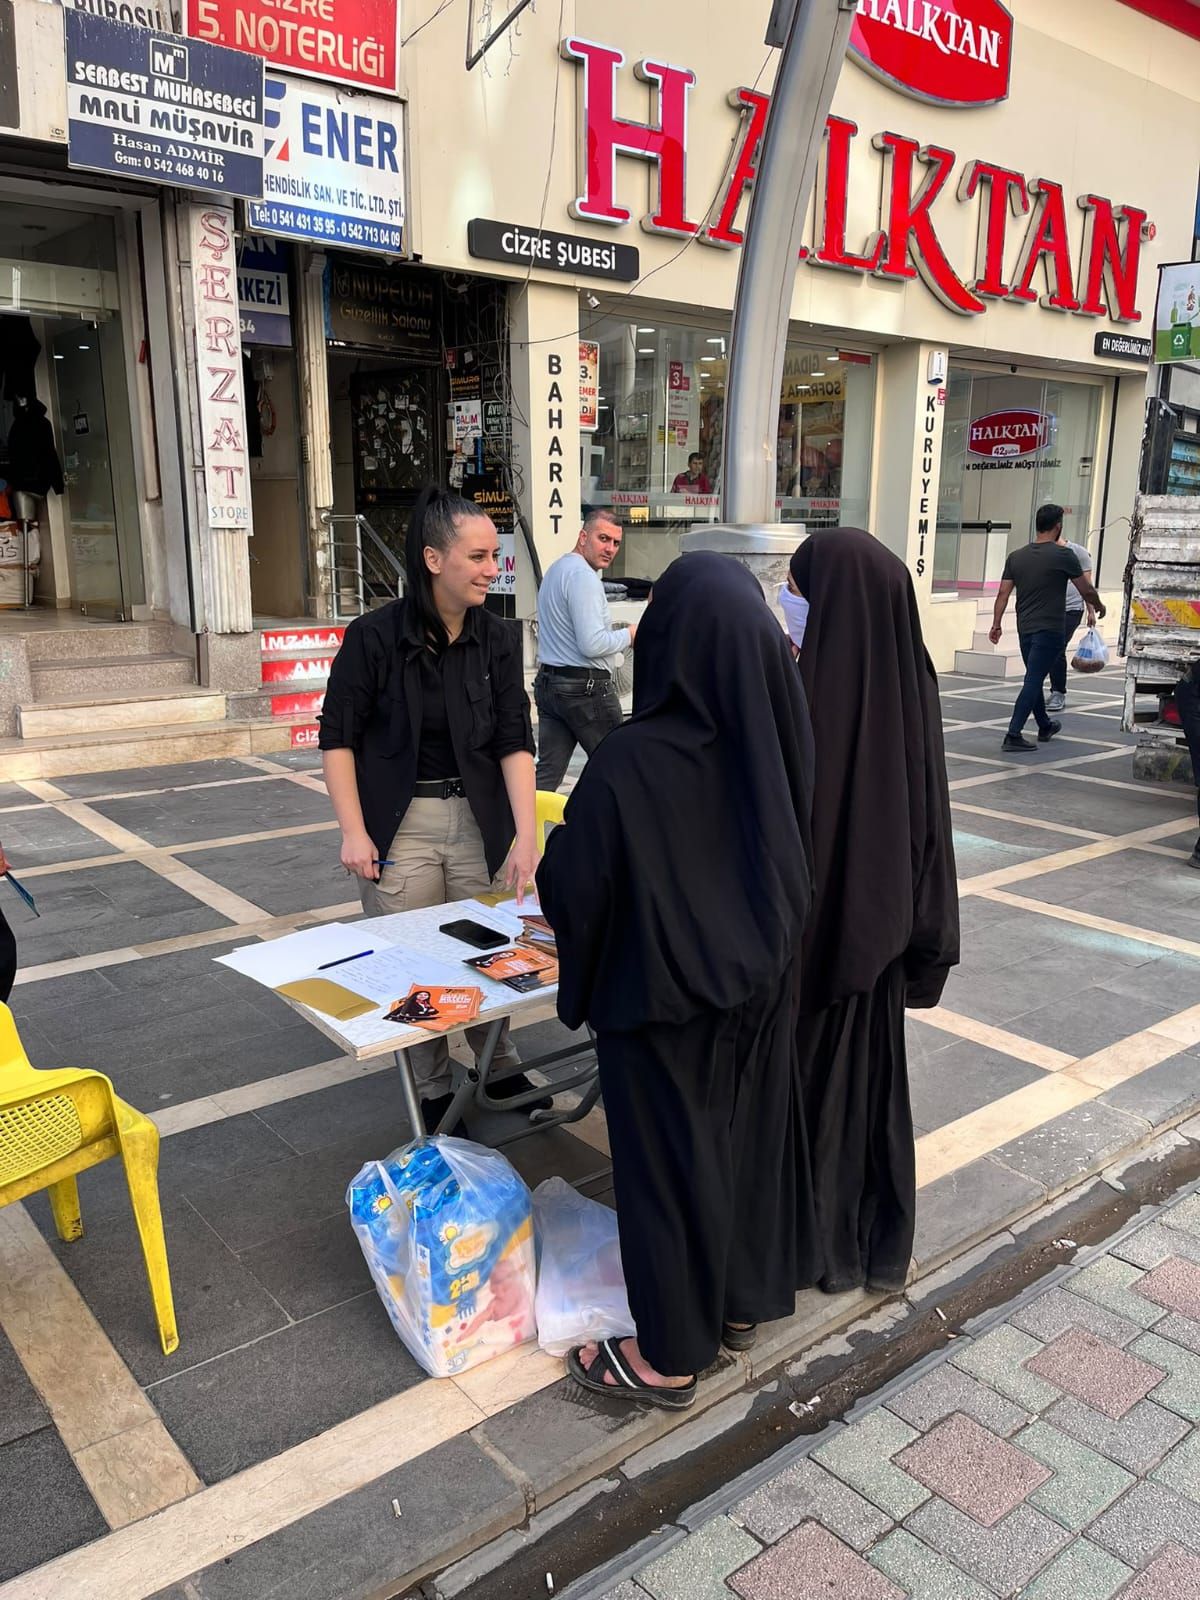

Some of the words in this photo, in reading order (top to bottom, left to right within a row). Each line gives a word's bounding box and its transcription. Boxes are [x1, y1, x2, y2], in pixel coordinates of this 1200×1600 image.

[199, 2, 225, 41] 5.
[235, 9, 385, 78] NOTERLİĞİ
[75, 61, 149, 95] SERBEST
[153, 79, 256, 119] MUHASEBECİ
[79, 94, 140, 125] MALİ
[150, 108, 254, 149] MÜŞAVİR
[302, 102, 399, 174] ENER
[112, 132, 162, 154] Hasan
[166, 144, 225, 167] ADMİR
[114, 151, 142, 167] Gsm:
[144, 157, 151, 168] 0
[154, 158, 173, 173] 542
[176, 161, 194, 177] 468
[197, 165, 209, 180] 40
[213, 169, 224, 183] 16
[314, 185, 334, 204] SAN.
[336, 189, 348, 206] VE
[350, 188, 367, 210] TİC.
[369, 196, 387, 214] LTD.
[389, 197, 404, 220] ŞTİ.
[254, 206, 271, 222] Tel:
[272, 210, 277, 224] 0
[279, 212, 294, 228] 541
[296, 214, 311, 230] 431
[313, 217, 324, 232] 35
[325, 219, 335, 235] 95
[341, 223, 347, 237] 0
[348, 225, 363, 240] 542
[364, 227, 378, 243] 713
[379, 230, 390, 245] 04
[391, 231, 400, 247] 09
[501, 228, 551, 259] CİZRE
[557, 242, 616, 270] ŞUBESİ
[340, 302, 389, 326] Güzellik
[391, 309, 432, 331] Salonu
[199, 212, 245, 499] ŞERZAT
[1102, 338, 1111, 350] EN
[672, 371, 680, 386] 3
[548, 354, 563, 534] BAHARAT
[972, 422, 1043, 441] HALKTAN
[916, 396, 936, 577] KURUYEMİŞ
[211, 505, 249, 520] STORE
